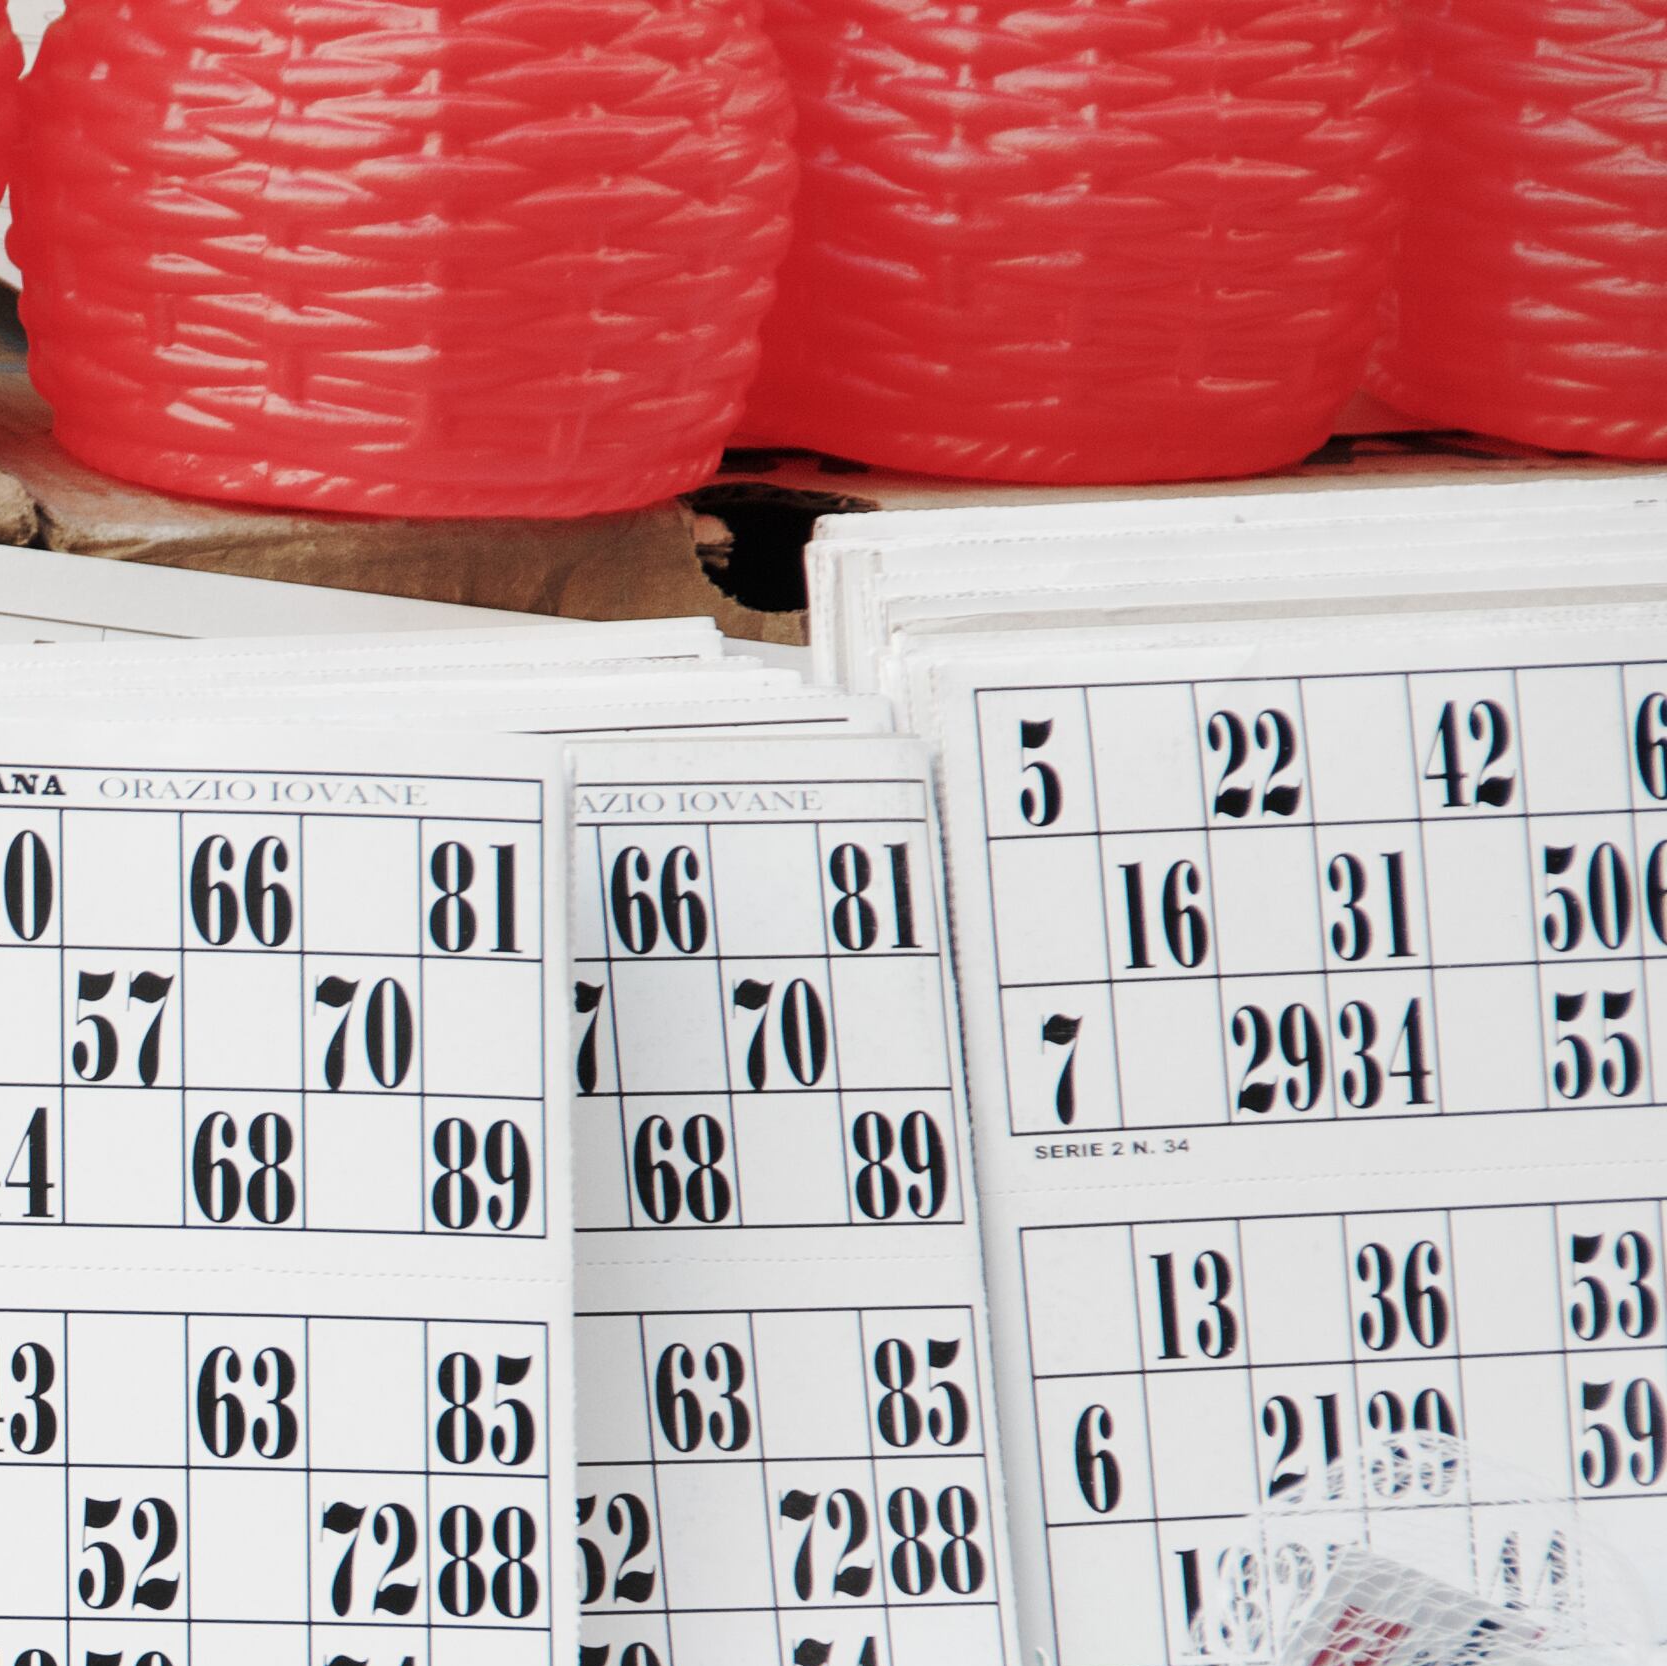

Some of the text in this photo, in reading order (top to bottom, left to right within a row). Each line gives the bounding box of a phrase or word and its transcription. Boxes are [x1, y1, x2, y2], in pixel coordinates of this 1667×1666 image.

[99, 779, 256, 800] ORAZIO
[271, 782, 427, 805] IOVANE
[1020, 700, 1514, 827] 5 22 42
[611, 842, 922, 955] 66 81
[1118, 842, 1632, 969] 16 31 50
[71, 970, 175, 1083] 57
[314, 975, 414, 1089] 70
[733, 977, 827, 1092] 70
[1042, 991, 1642, 1125] 7 29 34 55
[634, 1110, 947, 1224] 68 89
[1035, 1141, 1103, 1160] SERIE
[1165, 1138, 1189, 1154] 34
[1150, 1231, 1658, 1360] 13 36 53
[196, 1345, 299, 1460] 63
[435, 1351, 536, 1467] 85
[654, 1337, 971, 1453] 63 85
[1075, 1404, 1121, 1513] 6
[1262, 1393, 1346, 1501] 21
[1580, 1377, 1667, 1487] 59
[77, 1496, 181, 1611] 52
[321, 1501, 420, 1618] 72
[437, 1504, 540, 1620] 88
[779, 1487, 876, 1602] 72
[887, 1485, 986, 1596] 88
